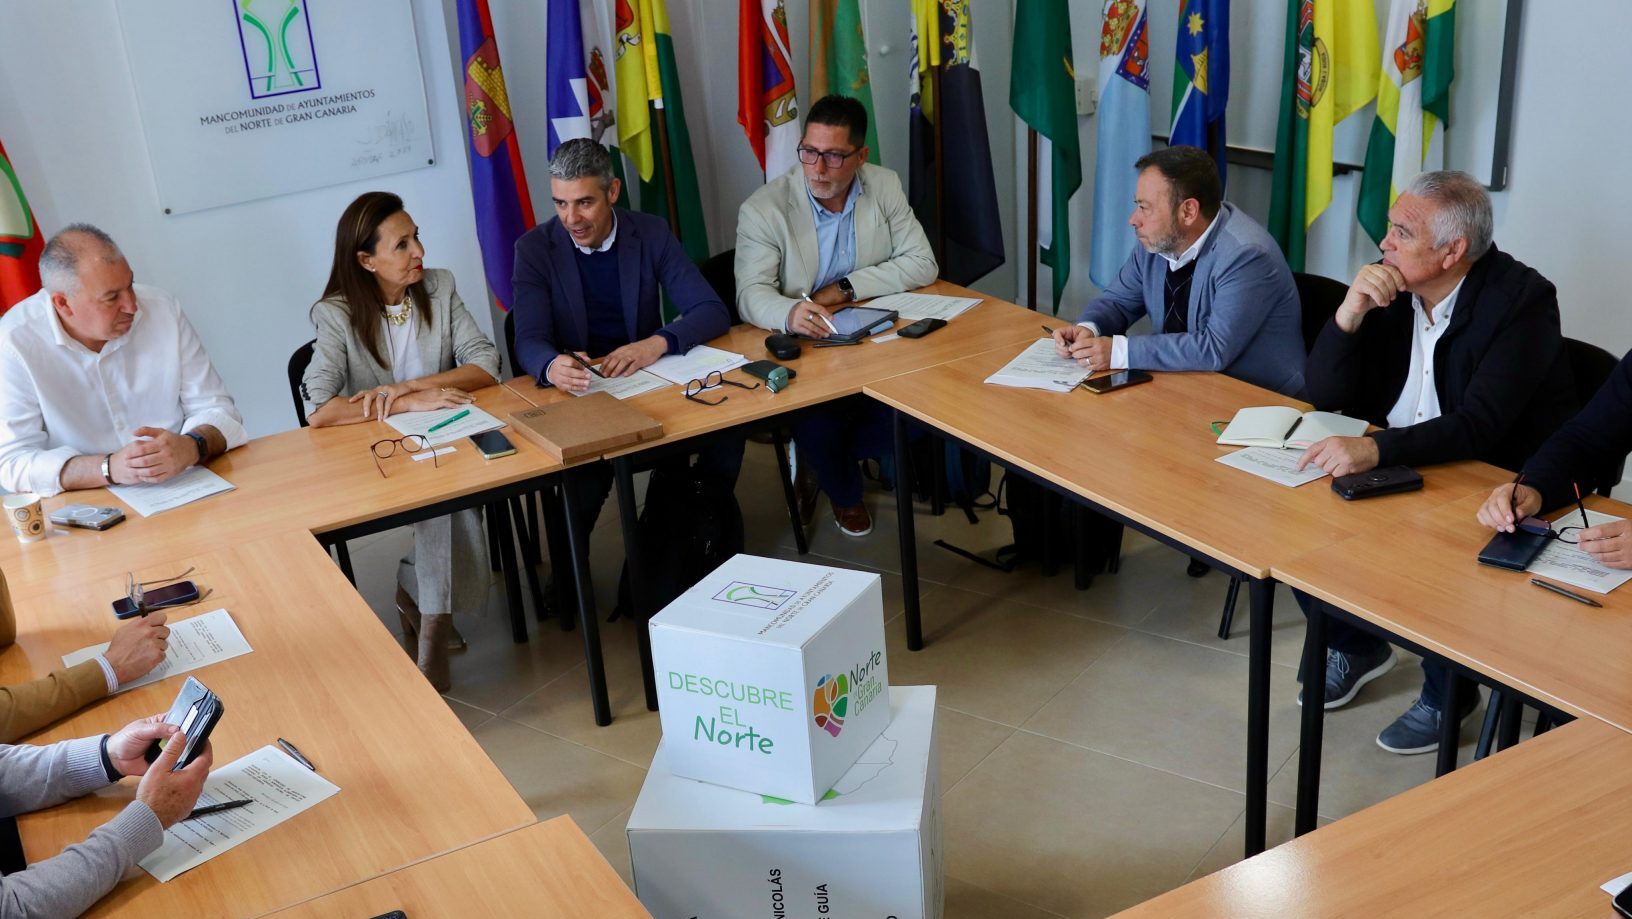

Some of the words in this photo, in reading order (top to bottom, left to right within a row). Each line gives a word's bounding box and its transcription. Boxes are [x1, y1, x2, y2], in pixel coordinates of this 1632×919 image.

[200, 104, 285, 125] MANCOMUNIDAD
[286, 103, 296, 111] DE
[298, 89, 375, 109] AYUNTAMIENTOS
[225, 125, 239, 134] DEL
[240, 118, 272, 131] NORTE
[274, 117, 284, 126] DE
[285, 112, 313, 124] GRAN
[315, 105, 357, 119] CANARIA
[850, 651, 881, 692] Norte
[858, 676, 875, 699] Gran
[668, 671, 794, 712] DESCUBRE
[854, 682, 882, 716] Canaria
[719, 705, 747, 728] EL
[694, 715, 774, 755] Norte
[814, 884, 829, 913] GUÍA
